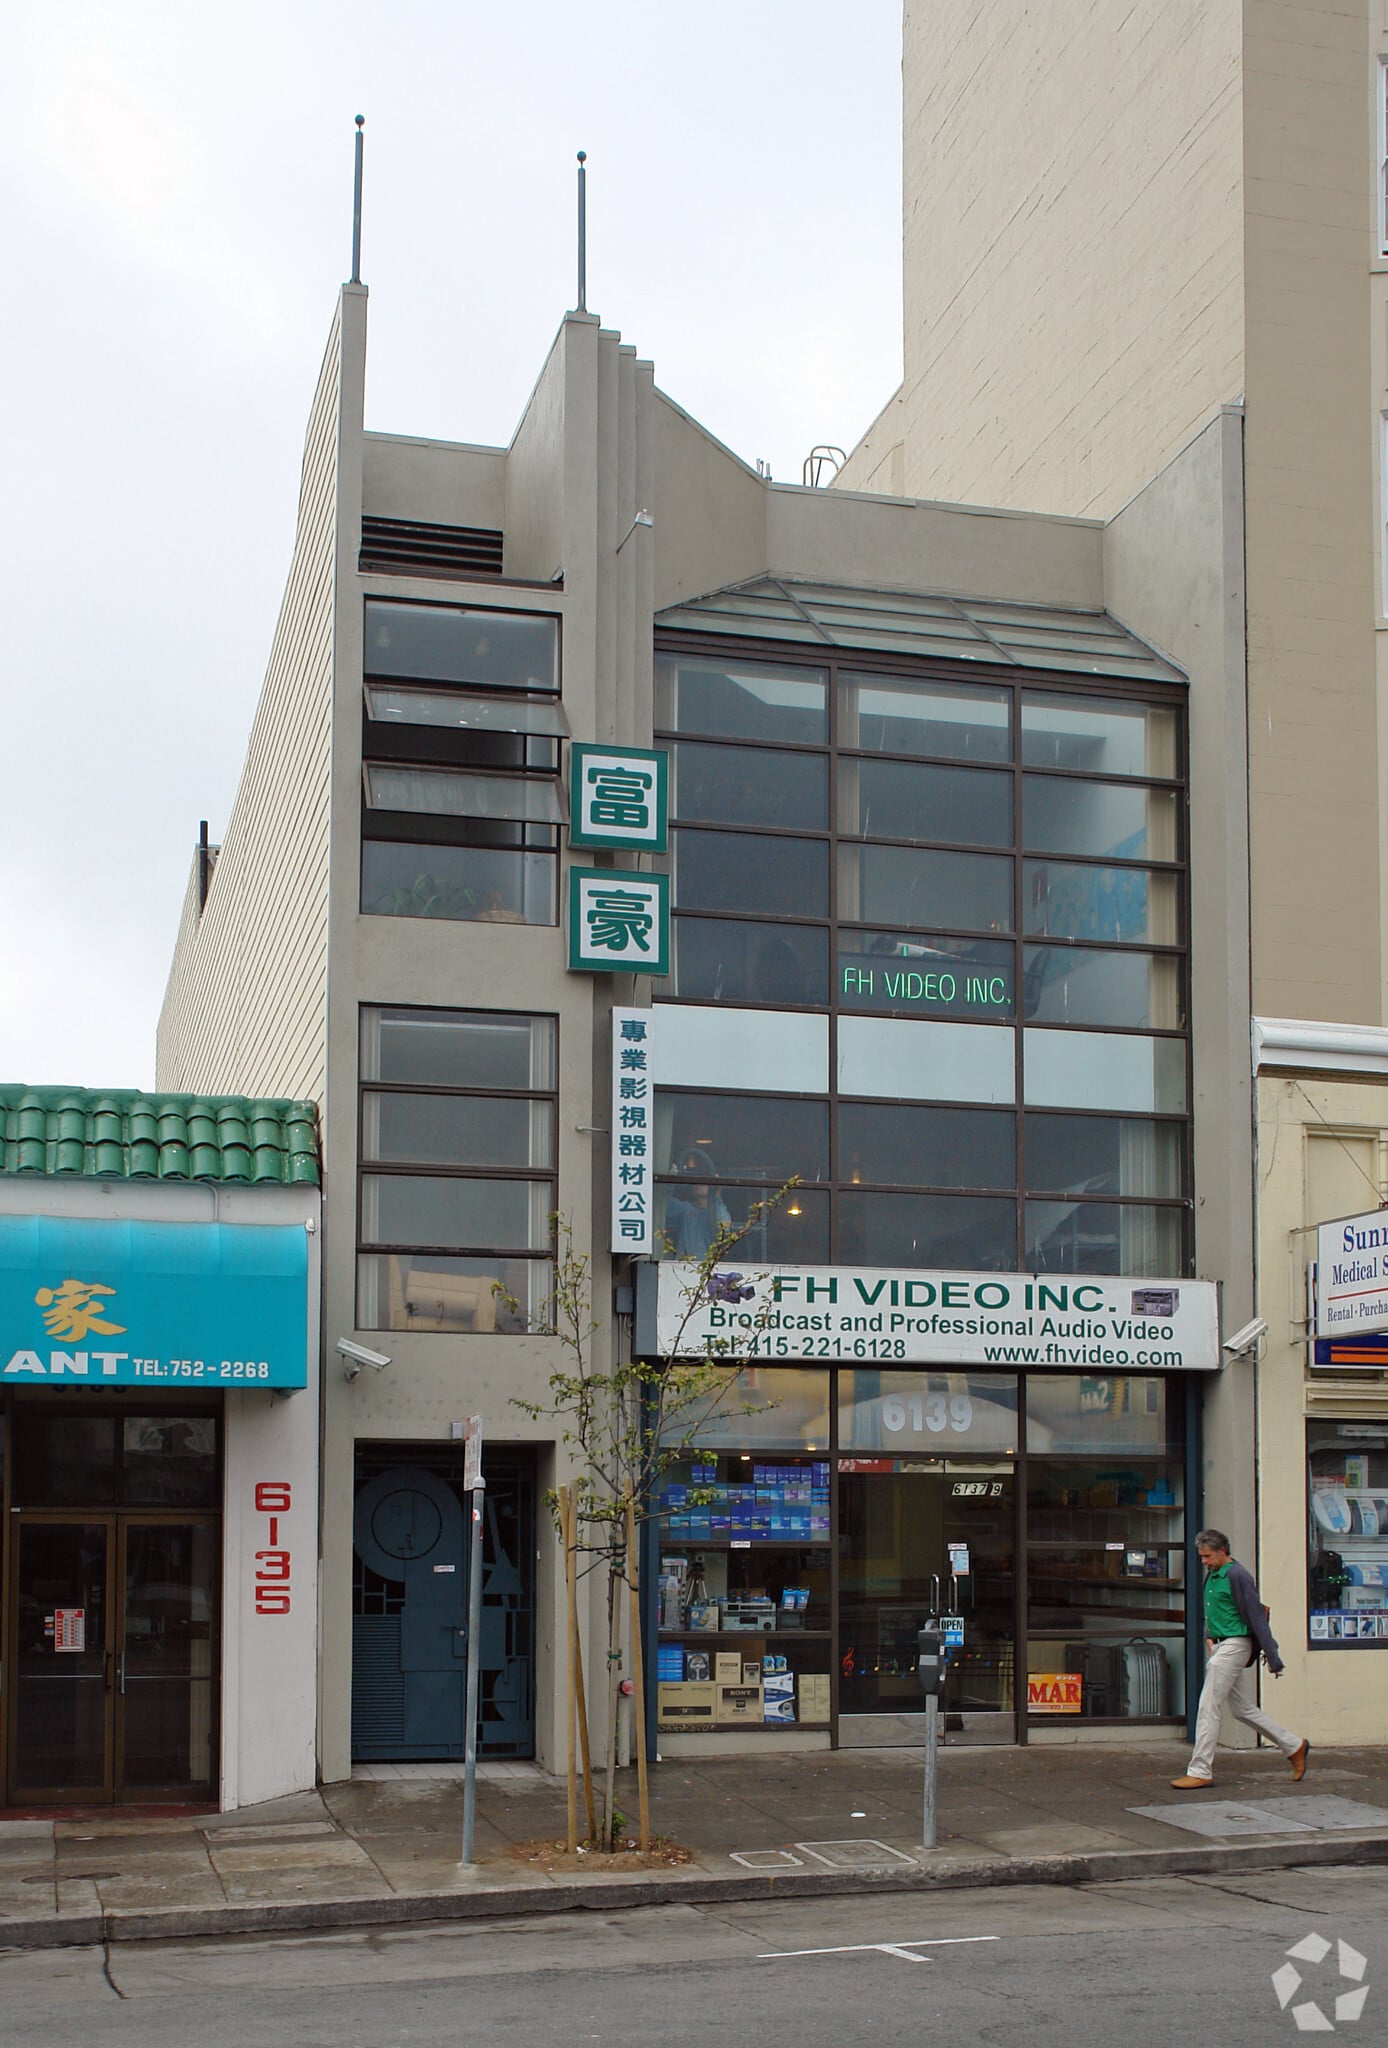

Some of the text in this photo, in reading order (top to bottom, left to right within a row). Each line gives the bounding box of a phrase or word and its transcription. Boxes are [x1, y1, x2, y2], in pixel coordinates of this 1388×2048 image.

[587, 766, 653, 830] 富
[587, 889, 653, 952] 豪
[843, 967, 874, 996] FH
[884, 972, 956, 1002] VIDEO
[618, 1019, 648, 1242] 專業影視器材公司
[1332, 1257, 1378, 1286] Medical
[35, 1279, 128, 1343] 家
[773, 1275, 1116, 1313] FH VIDEO INC.
[709, 1307, 1174, 1341] Broadcast and Professional Audio Video
[1327, 1303, 1354, 1322] Rental
[3, 1350, 129, 1376] ANT
[984, 1343, 1183, 1367] www.fhvideo.com
[882, 1393, 973, 1432] 6139
[953, 1483, 989, 1495] 6137
[254, 1482, 292, 1615] 6135
[941, 1619, 963, 1631] OPEN
